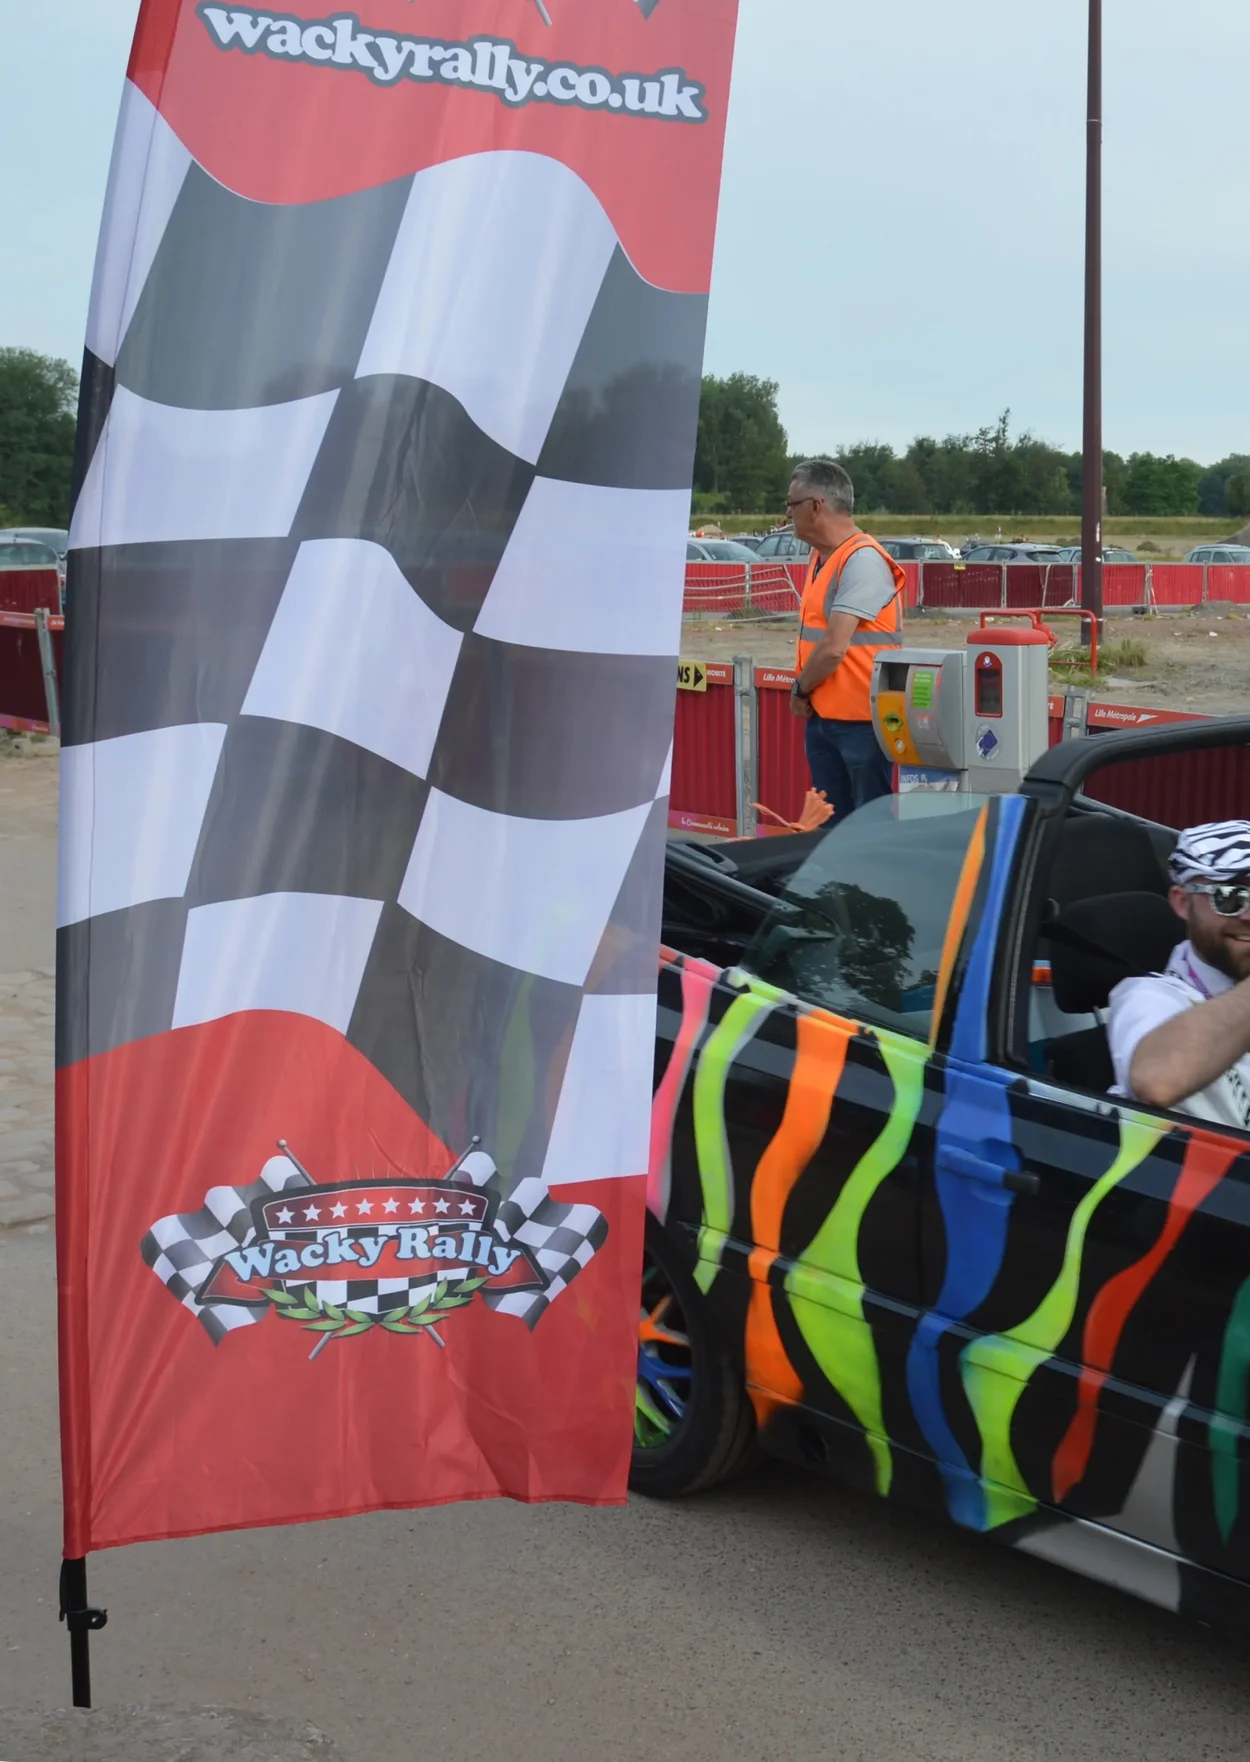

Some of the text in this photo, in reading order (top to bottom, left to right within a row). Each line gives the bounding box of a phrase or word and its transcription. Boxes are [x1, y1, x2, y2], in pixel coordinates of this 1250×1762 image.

[204, 7, 702, 118] wackyrally.co.uk
[224, 1226, 522, 1282] Wacky Rally
